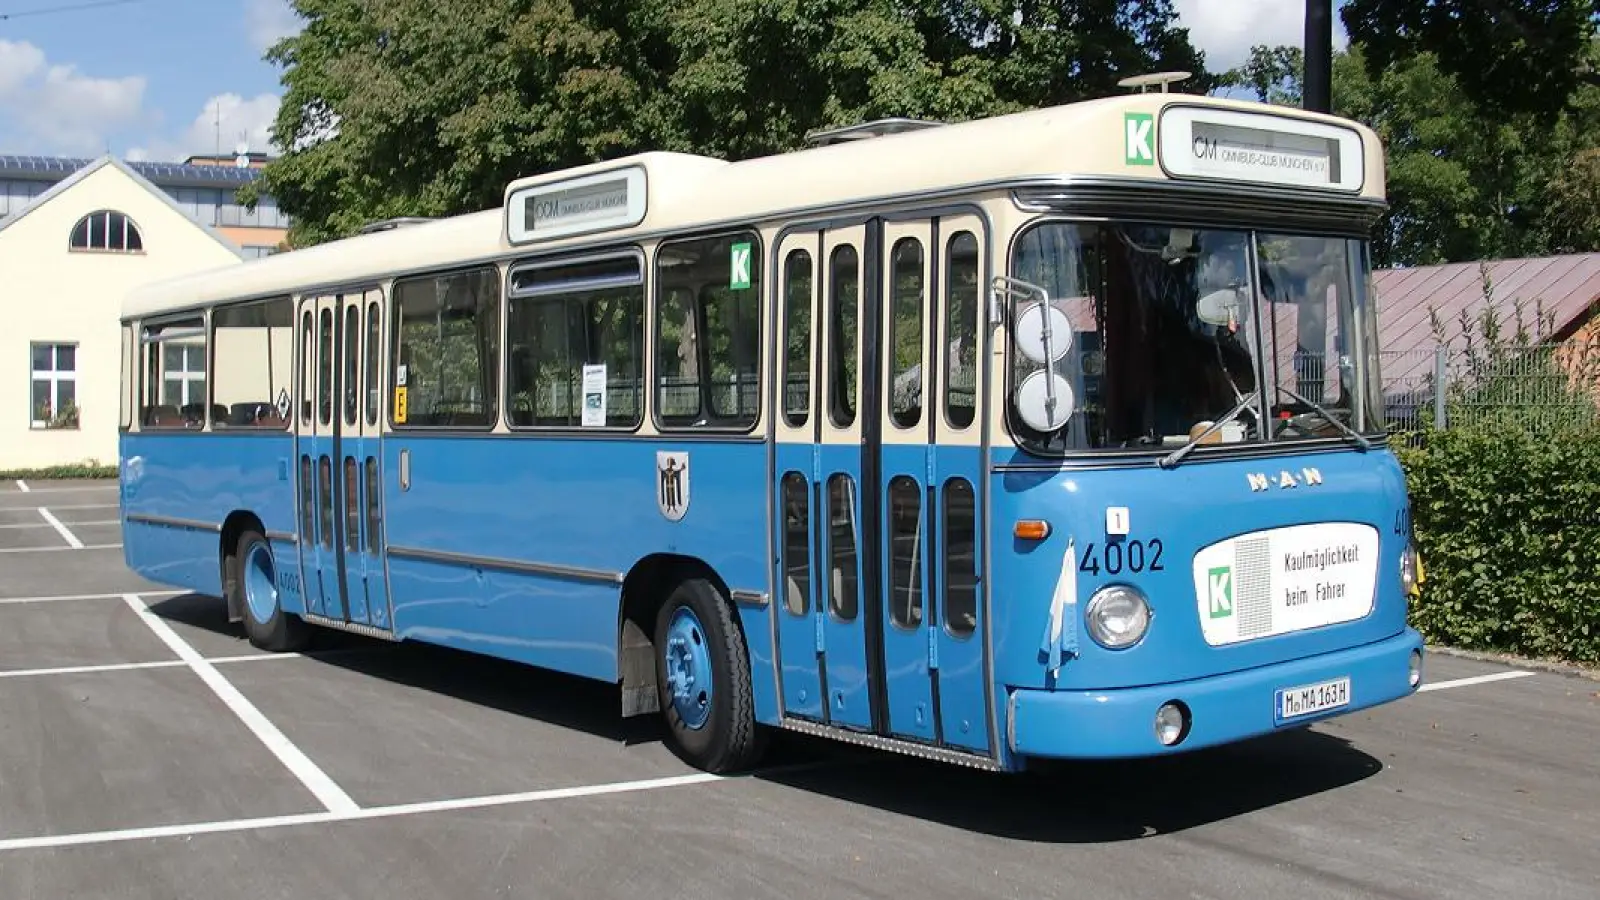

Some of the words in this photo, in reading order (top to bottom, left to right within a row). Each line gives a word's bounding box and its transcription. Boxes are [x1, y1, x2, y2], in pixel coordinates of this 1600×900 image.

[1127, 119, 1153, 161] K
[1192, 136, 1217, 160] CM
[733, 249, 749, 284] K
[1079, 538, 1164, 576] 4002
[1284, 544, 1360, 573] Kaufmöglichkeit
[1209, 572, 1232, 613] K
[1285, 585, 1308, 607] beim
[1316, 581, 1345, 602] Fahrer
[1285, 693, 1294, 713] M
[1301, 689, 1316, 709] MA
